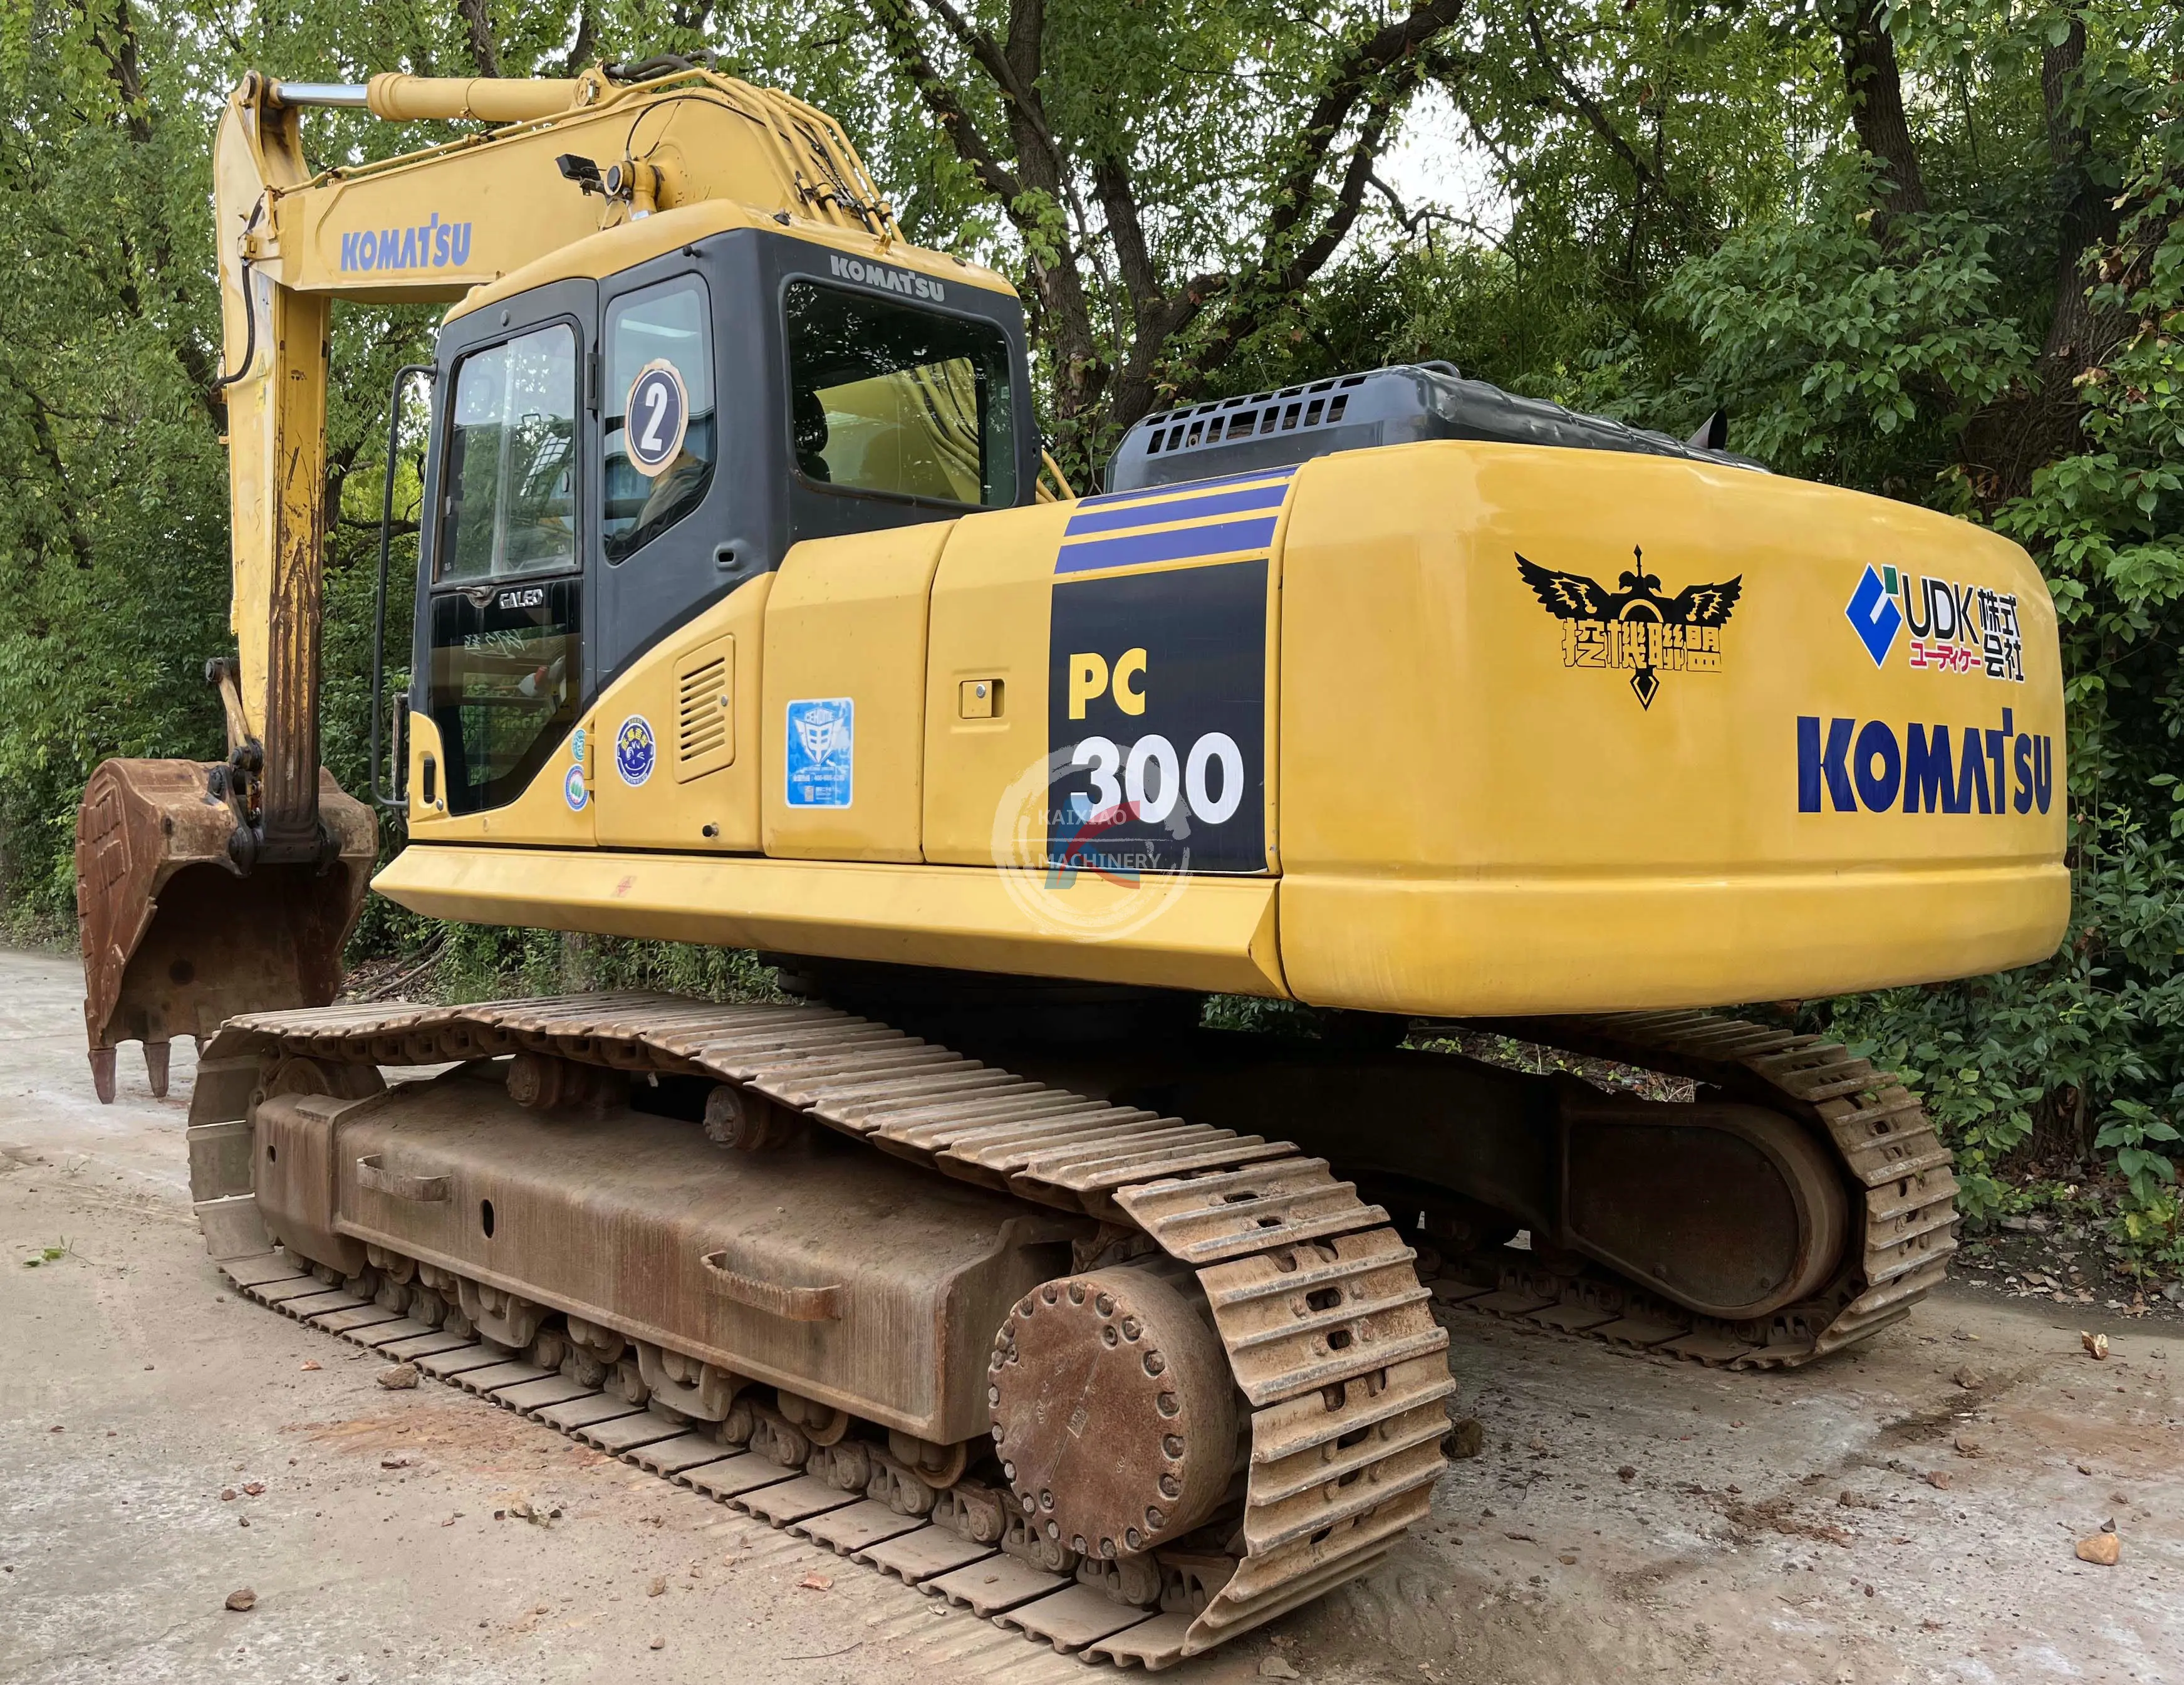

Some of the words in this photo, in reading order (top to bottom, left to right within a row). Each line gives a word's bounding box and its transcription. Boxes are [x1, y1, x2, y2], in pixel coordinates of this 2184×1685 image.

[340, 213, 471, 271] KOMATSU
[831, 255, 945, 302] KOMATSU
[641, 382, 668, 451] 2
[499, 589, 543, 609] GALEO
[1902, 575, 1980, 644] UDK
[1068, 647, 1147, 720] PC
[1910, 642, 1981, 672] ユーディケー
[1070, 731, 1244, 825] 300
[1797, 707, 2052, 815] KOMATSU
